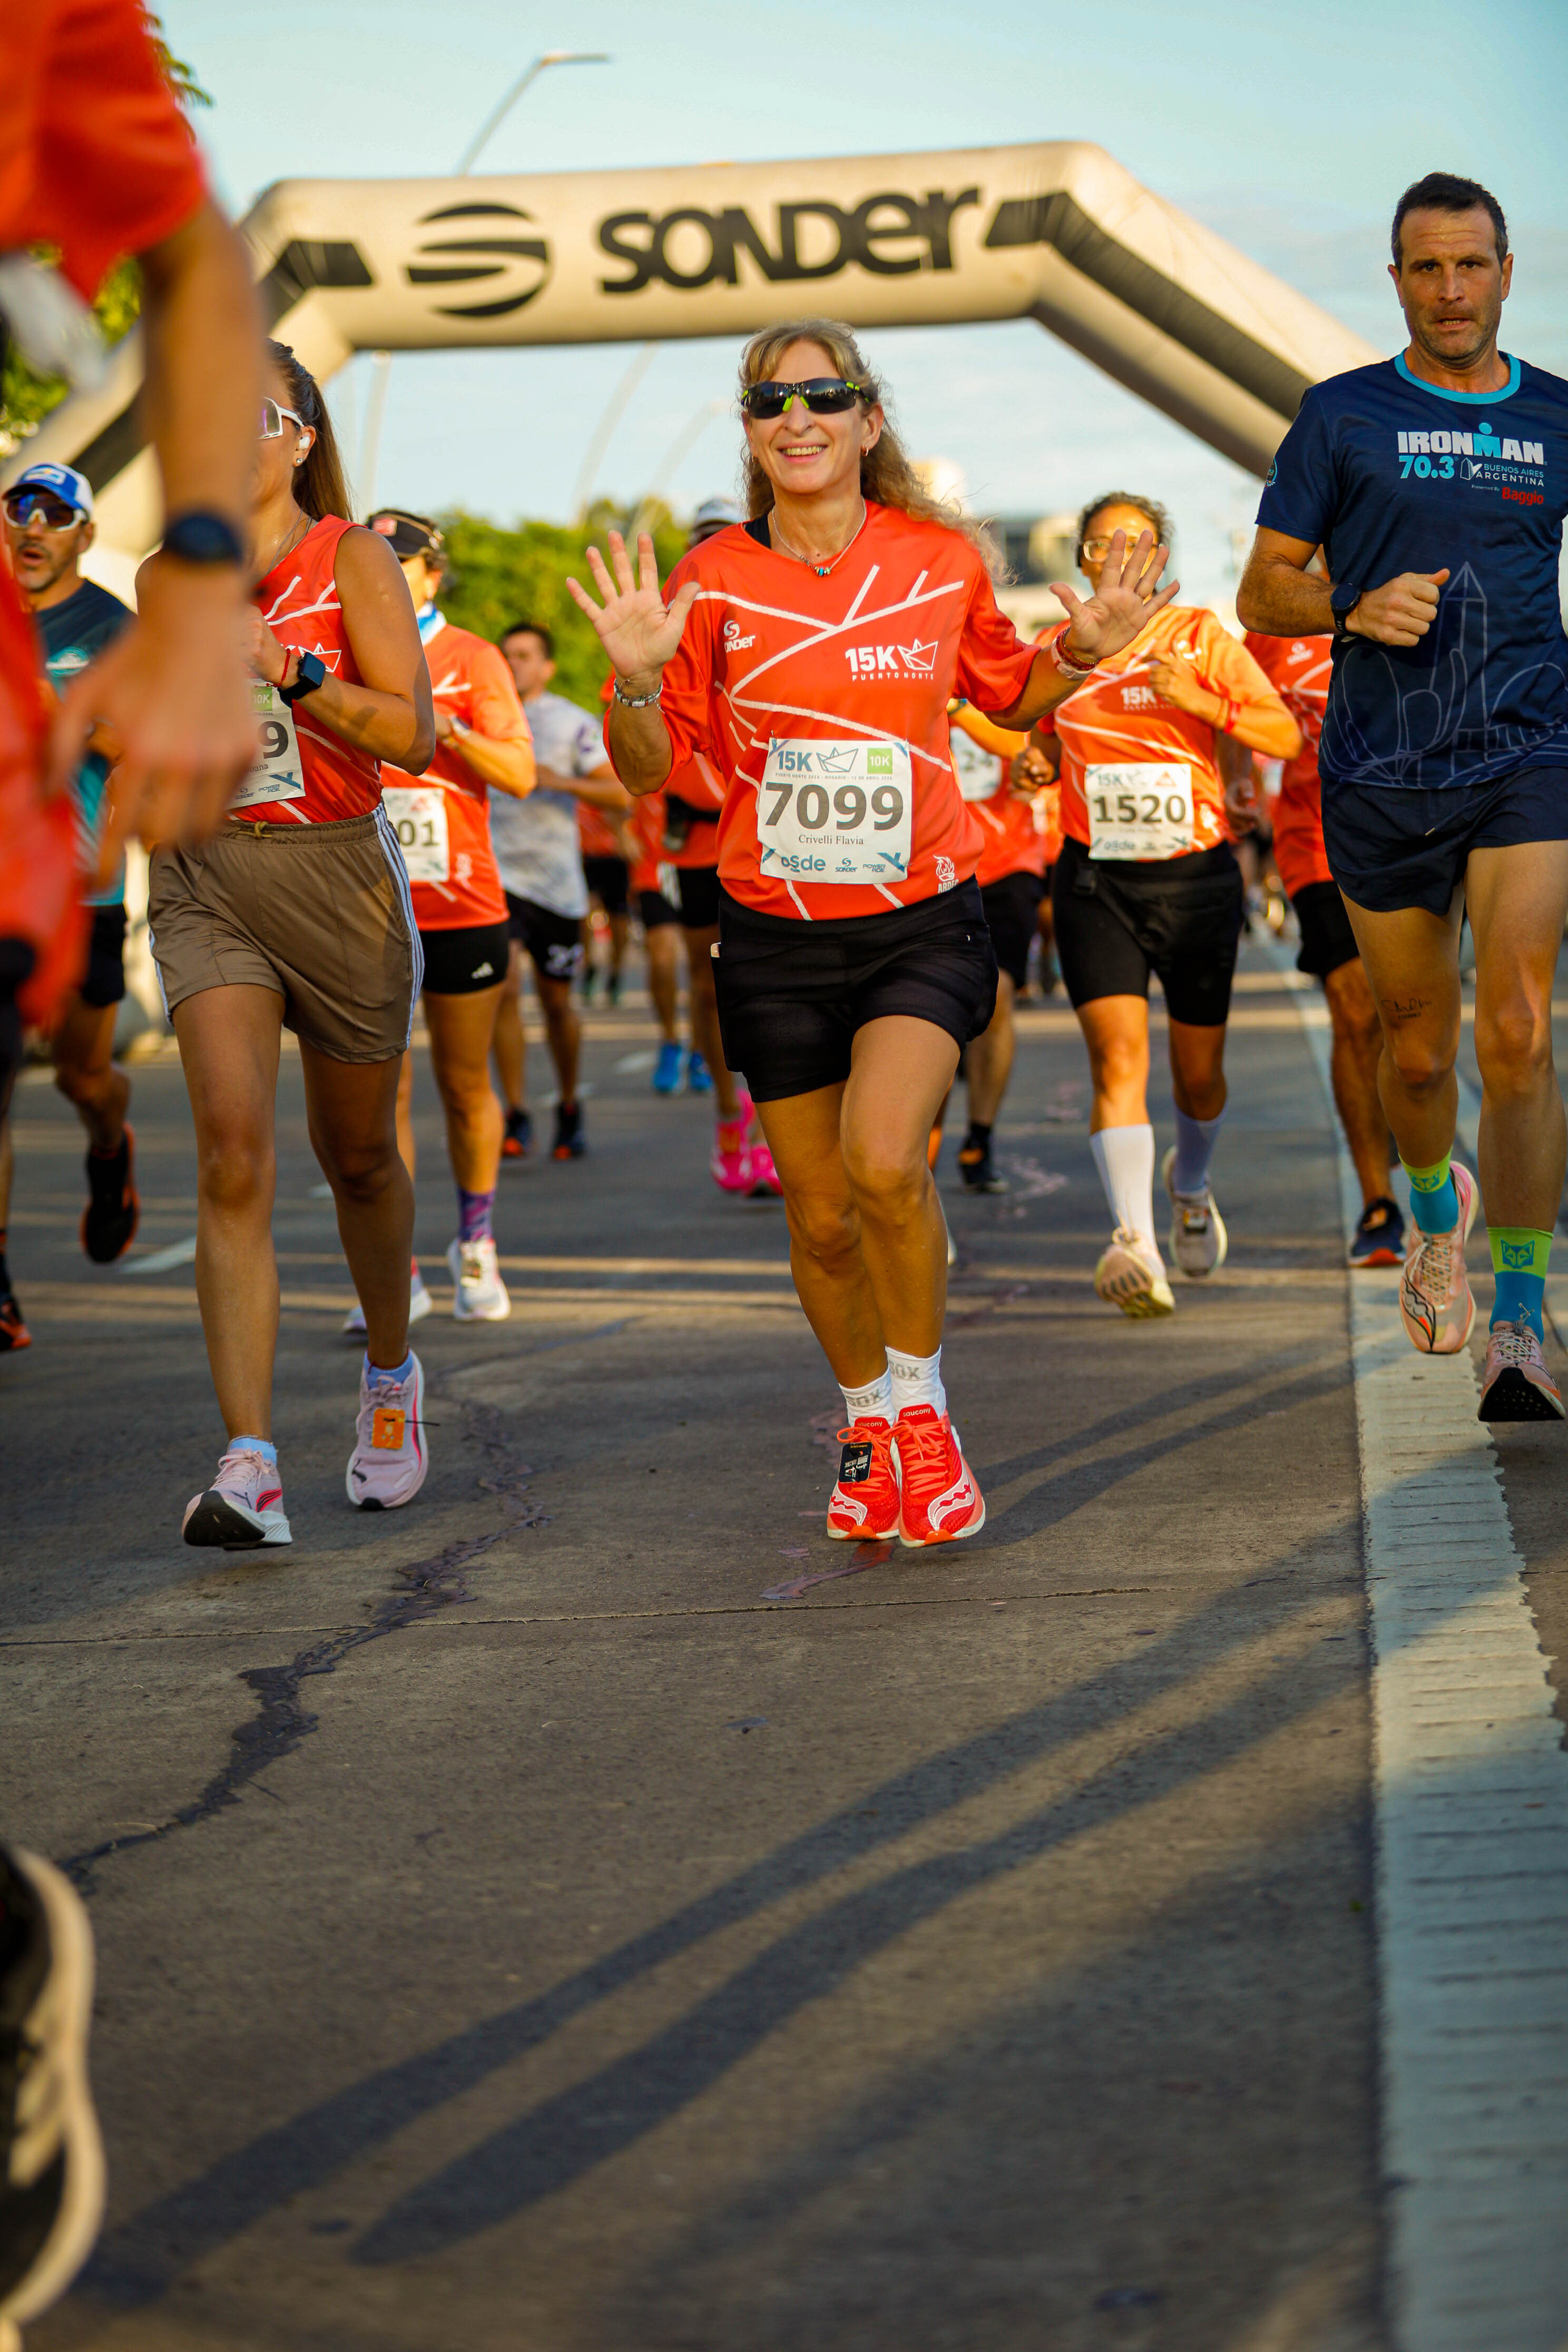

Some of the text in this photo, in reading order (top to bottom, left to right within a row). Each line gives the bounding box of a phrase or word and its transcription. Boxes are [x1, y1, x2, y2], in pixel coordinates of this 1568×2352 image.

[1397, 423, 1544, 465] IRONMAN
[1399, 456, 1454, 479] 70.3
[1484, 464, 1544, 478] BUENOS AIRES
[1476, 471, 1544, 487] ARGENTINA
[1502, 486, 1544, 506] Baggio
[845, 646, 898, 672] 15K
[852, 672, 899, 681] PUERTO
[777, 750, 813, 772] 15K
[869, 756, 890, 767] 10K
[765, 782, 904, 830] 7099
[1093, 795, 1185, 823] 1520
[799, 835, 864, 845] Crivelli Flavia
[781, 854, 826, 873] osde
[903, 1407, 931, 1417] saucony
